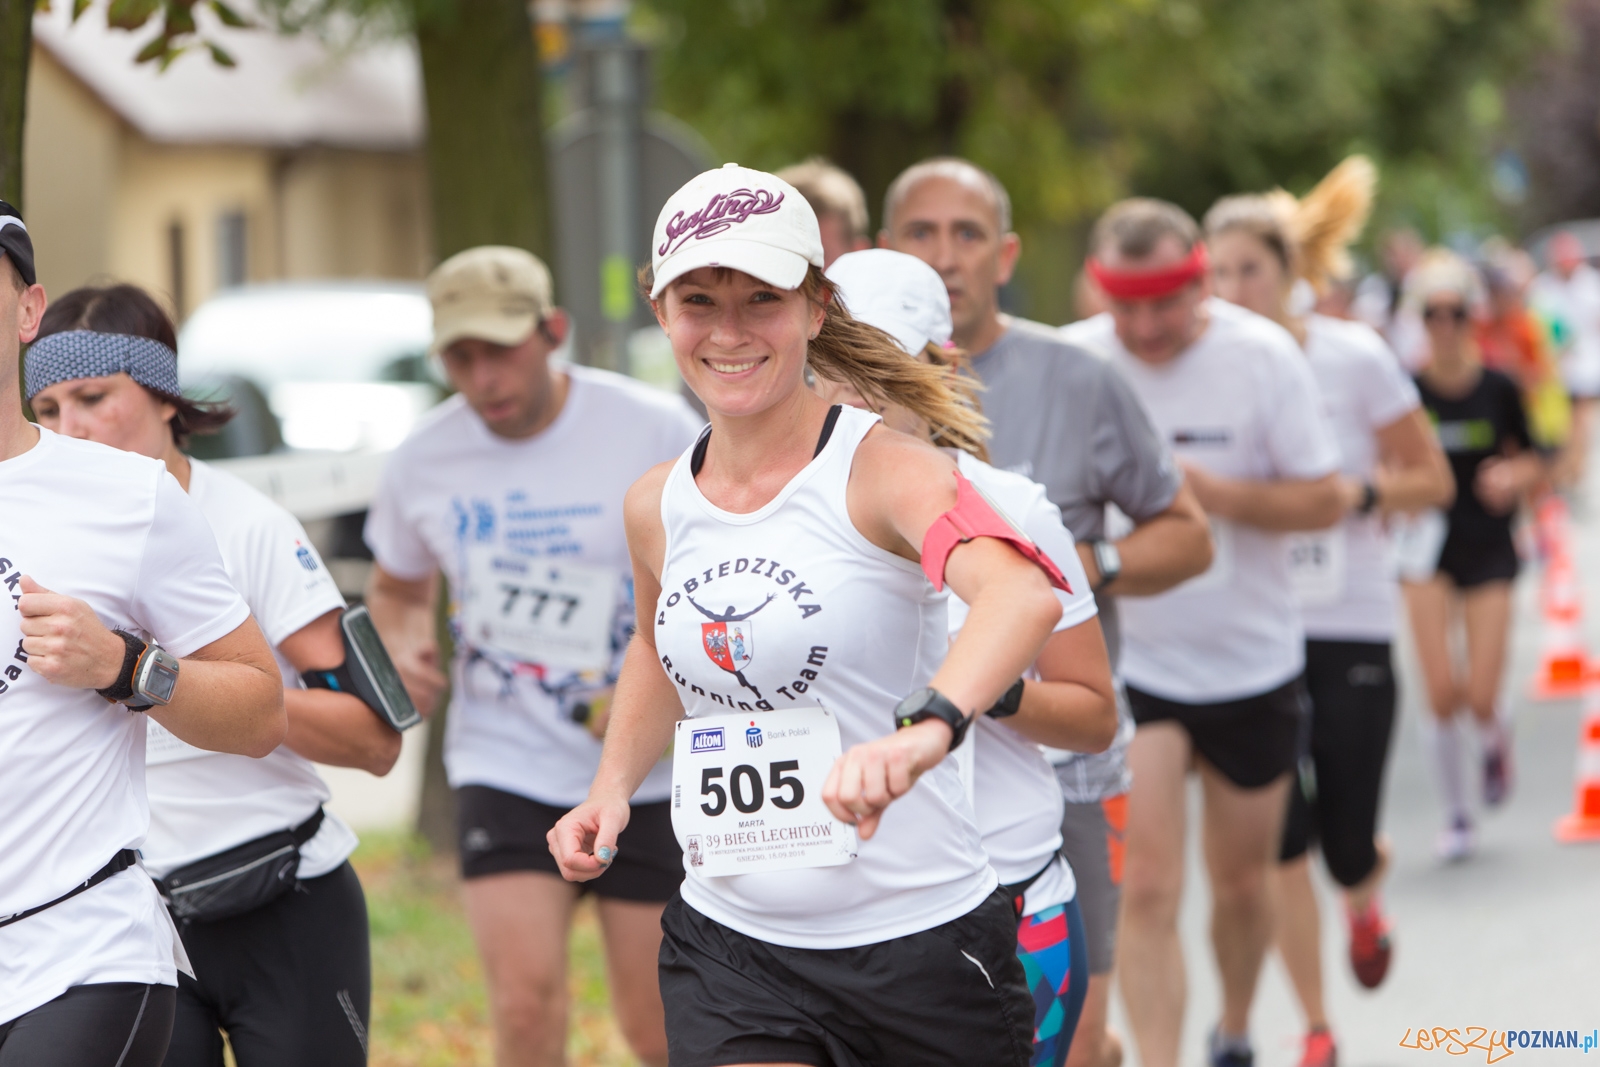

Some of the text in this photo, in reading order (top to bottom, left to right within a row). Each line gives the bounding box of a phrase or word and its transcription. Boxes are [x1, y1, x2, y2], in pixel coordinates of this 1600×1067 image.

[499, 583, 580, 625] 777
[657, 557, 822, 626] POBIEDZISKA
[661, 645, 829, 712] Running Team
[767, 726, 810, 740] Bank Polski
[700, 759, 805, 817] 505
[706, 822, 833, 848] 39 BIEG LECHITÓW
[738, 819, 765, 828] MARTA
